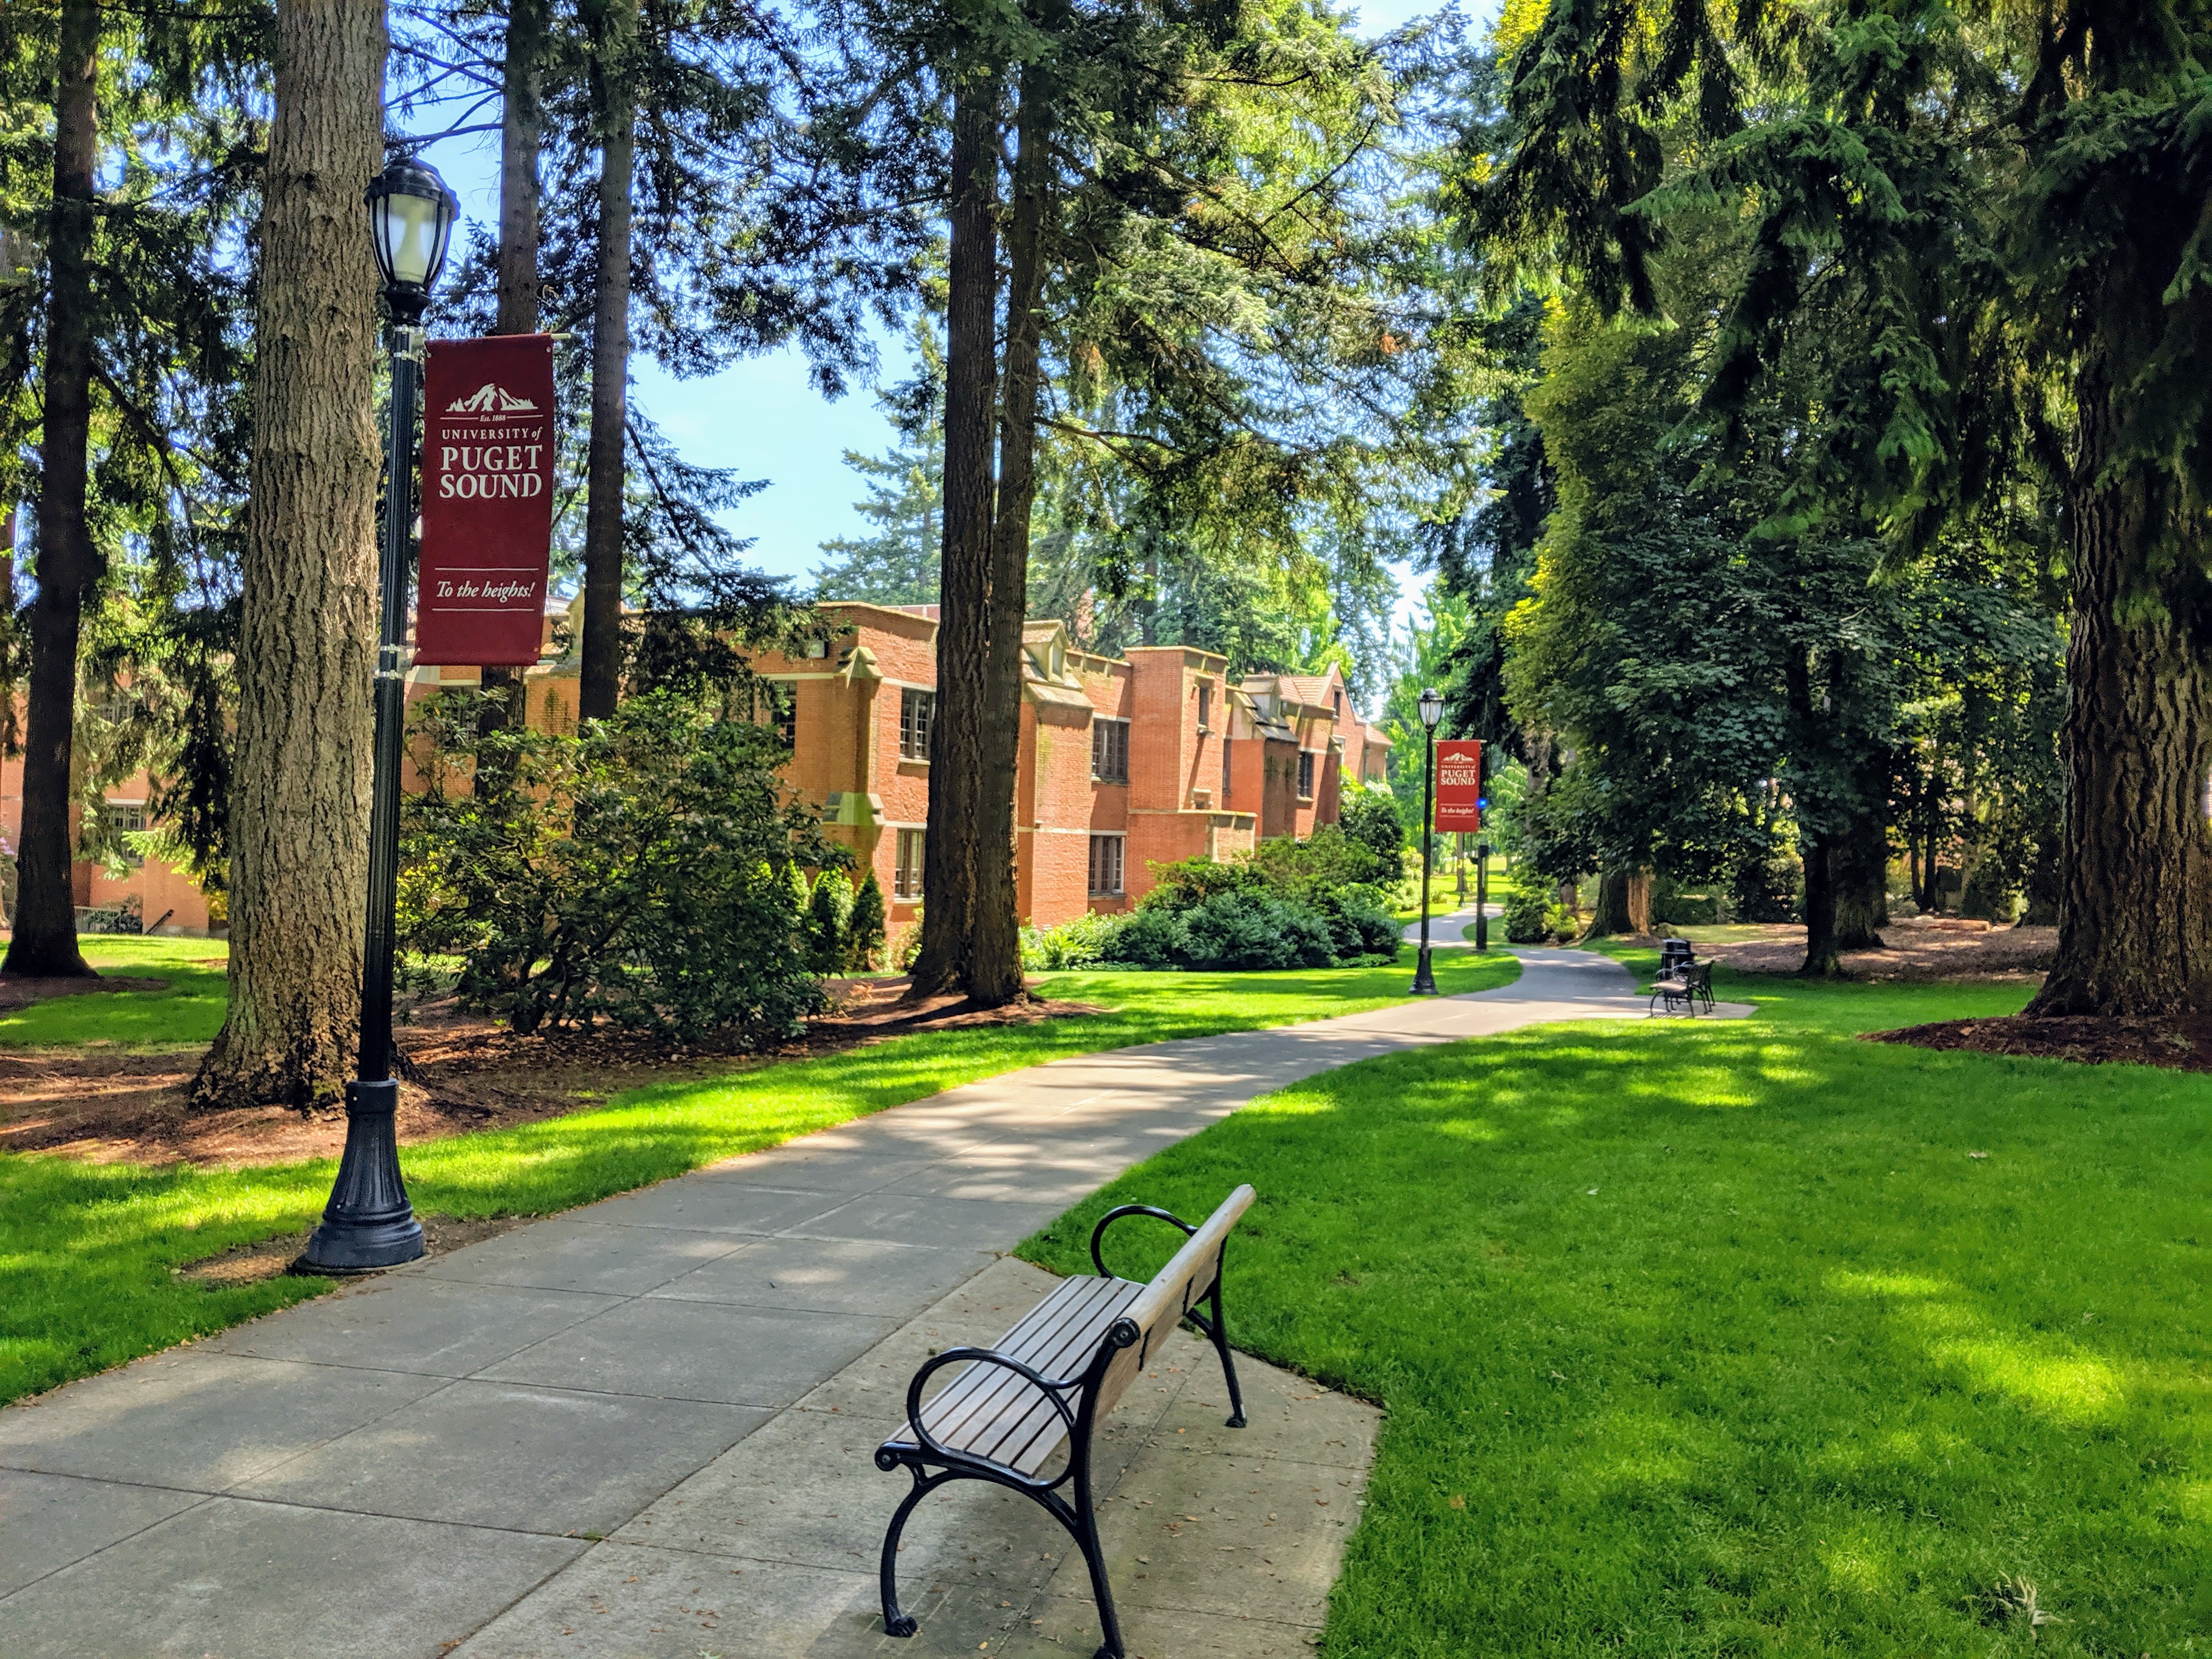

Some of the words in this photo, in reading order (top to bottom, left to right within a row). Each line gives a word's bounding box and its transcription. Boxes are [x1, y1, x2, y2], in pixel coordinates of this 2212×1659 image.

[442, 428, 529, 439] UNIVERSITY
[531, 426, 543, 441] of
[441, 444, 543, 471] PUGET
[439, 473, 542, 498] SOUND
[436, 580, 453, 597] To
[456, 580, 479, 597] the
[481, 580, 535, 603] heights!
[1441, 769, 1476, 777] PUGET
[1441, 777, 1476, 786] SOUND
